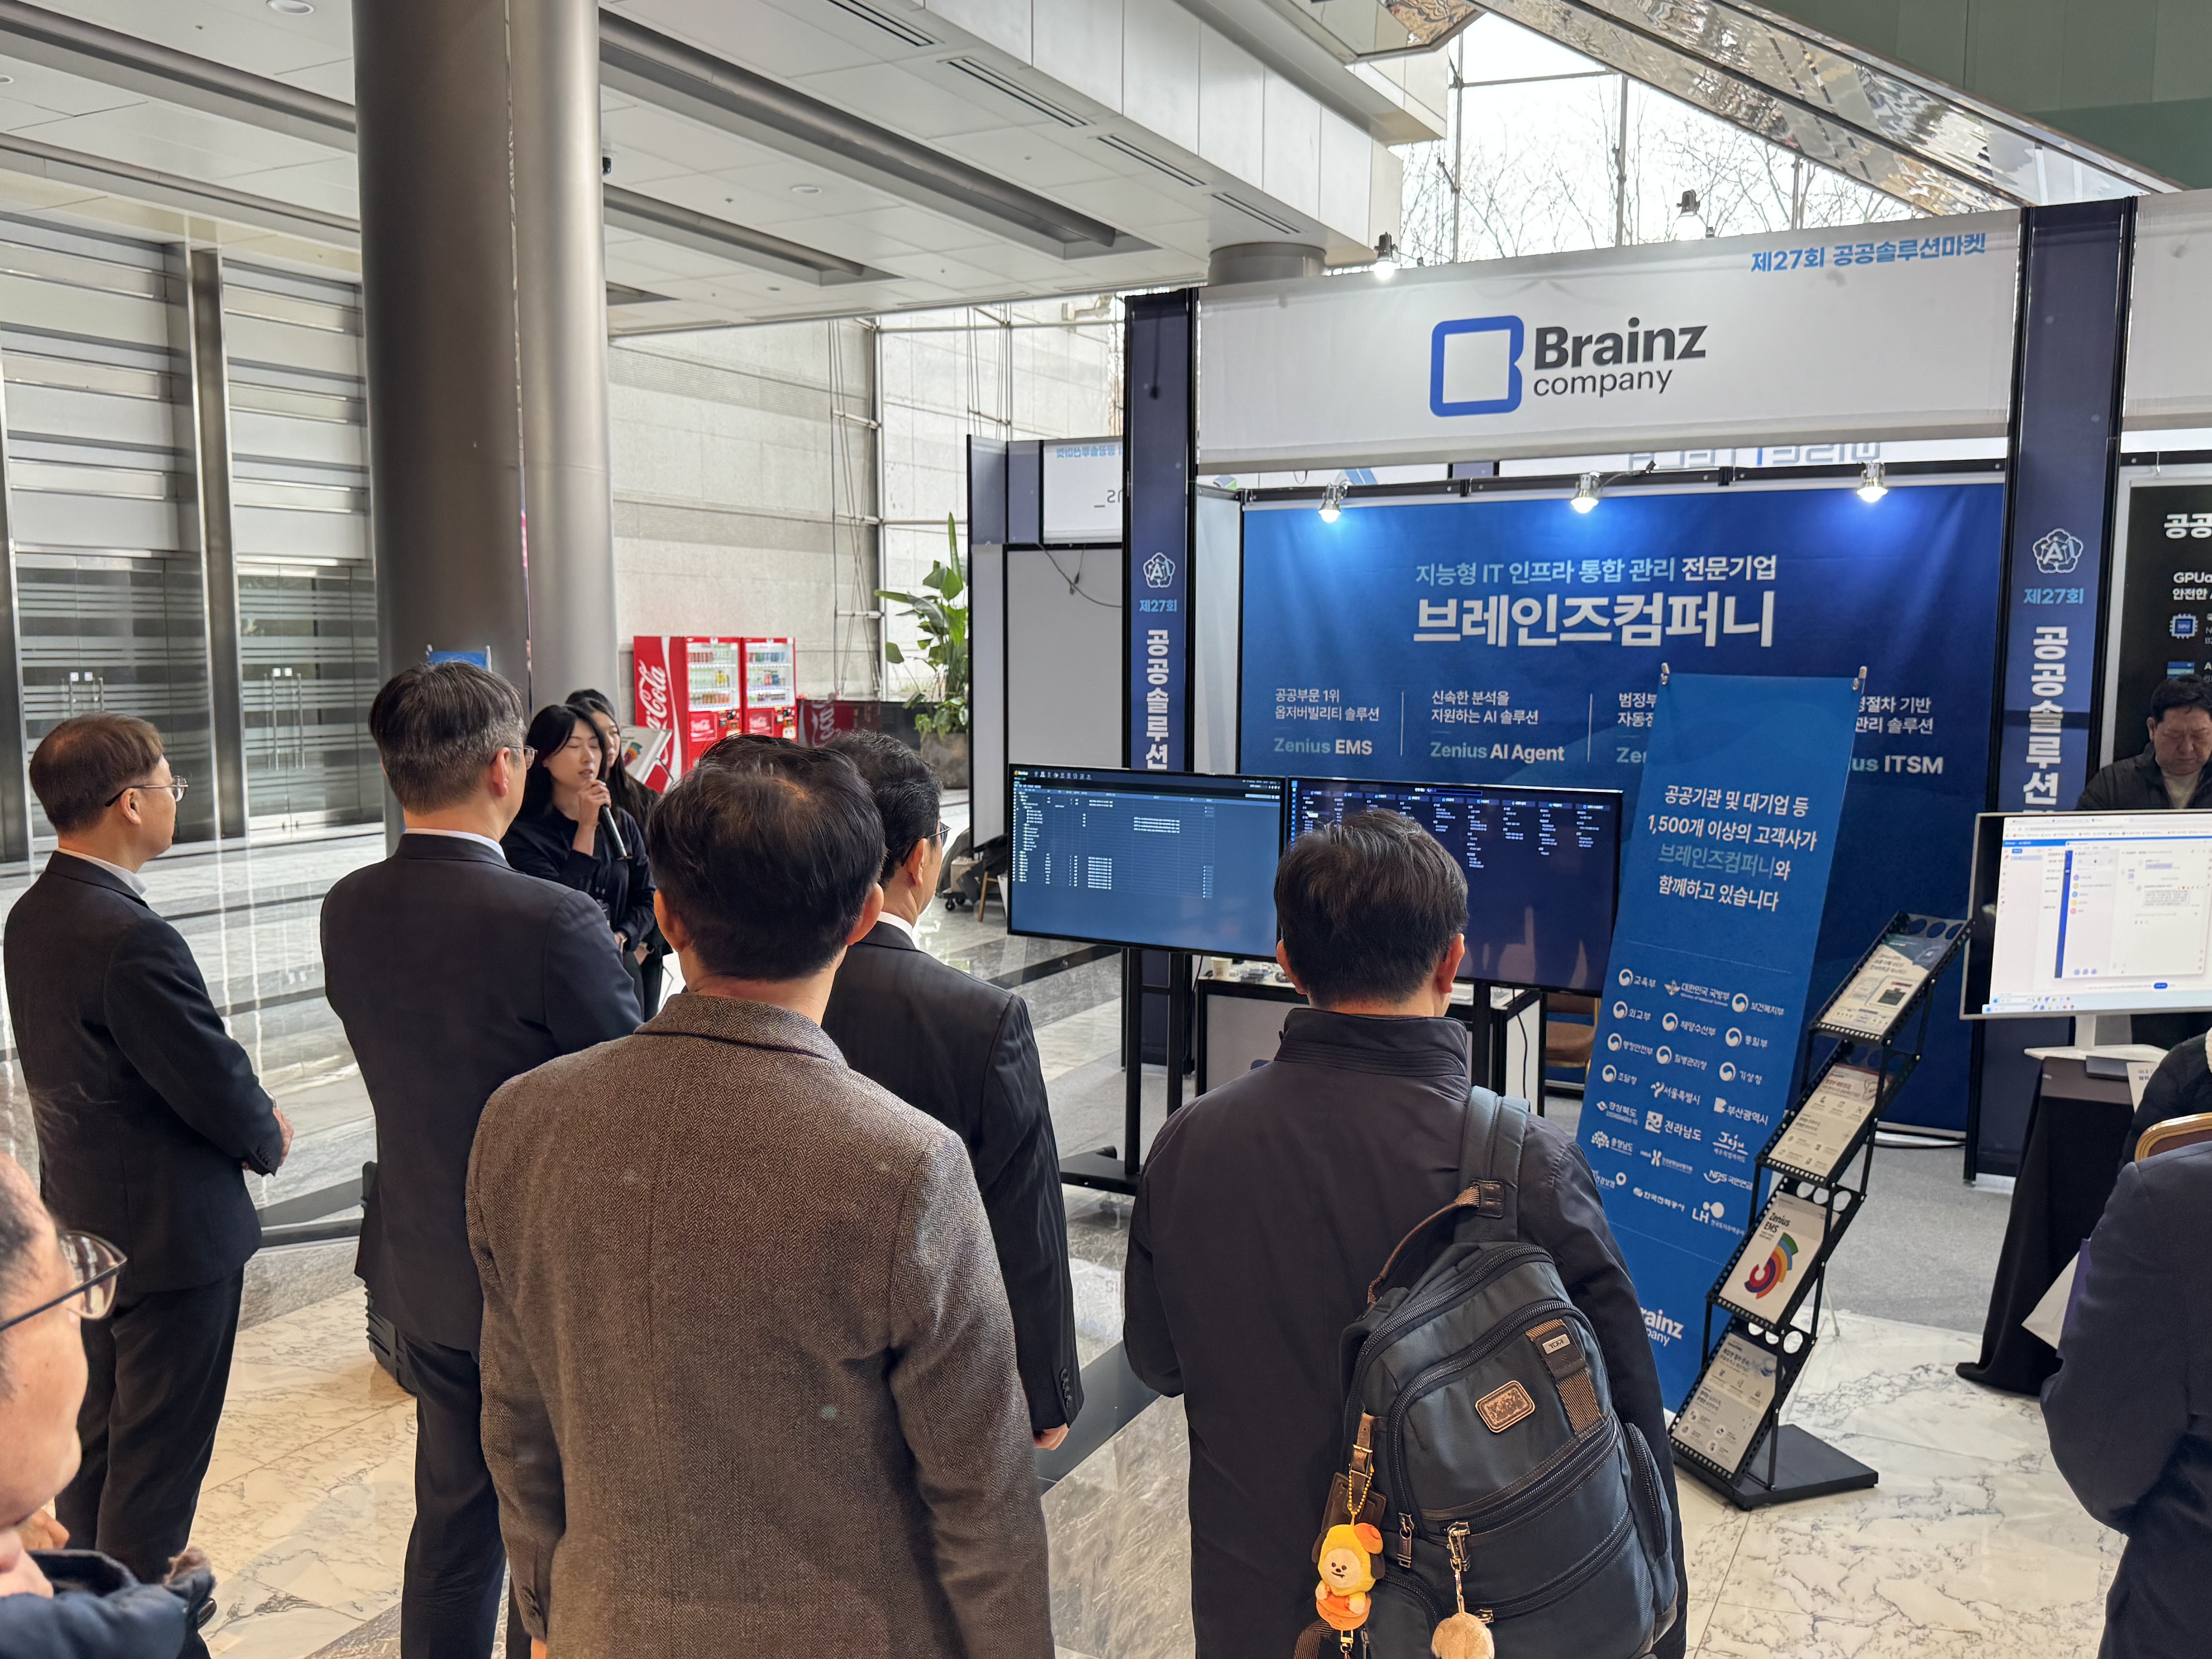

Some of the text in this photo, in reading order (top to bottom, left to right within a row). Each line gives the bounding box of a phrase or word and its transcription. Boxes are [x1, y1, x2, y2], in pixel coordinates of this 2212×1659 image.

[1751, 233, 1986, 272] 제27회 공공솔루션마켓
[1534, 317, 1708, 371] Brainz
[1534, 369, 1673, 398] company
[2164, 513, 2212, 539] 공공
[1416, 555, 1777, 586] 지능형 IT 인프라 통합 관리 전문기업
[2023, 587, 2084, 605] 제27회
[2172, 587, 2208, 600] 안전한
[1139, 599, 1177, 613] 제27회
[1413, 591, 1774, 647] 브레인즈컴퍼니
[1275, 689, 1340, 703] 공공부문 1위
[1432, 690, 1510, 706] 신속한 분석을
[1900, 697, 1931, 713] 기반
[1275, 706, 1379, 721] 옵저버빌리티 솔루션
[1431, 709, 1539, 725] 지원하는 AI 솔루션
[2023, 626, 2068, 809] 공공솔루션
[1887, 717, 1933, 735] 솔루션
[1274, 738, 1372, 755] Zenius EMS
[1431, 742, 1565, 764] Zenius AI Agent
[1884, 755, 1944, 774] ITSM
[1665, 785, 1809, 817] 공공기관 및 대기업 등
[1648, 814, 1817, 852] 1,500개 이상의 고객사가
[1658, 843, 1791, 881] 브레인즈컴퍼니와
[1659, 875, 1779, 912] 함께하고 있습니다
[1634, 975, 1656, 988] 교육부
[1681, 982, 1708, 996] 대한민국
[1628, 1008, 1651, 1021] 외교부
[1681, 1020, 1716, 1037] 해양수산부
[1739, 1071, 1762, 1085] 기상청
[1664, 1087, 1700, 1106] 서울특별시
[1727, 1105, 1769, 1126] 부산광역시
[1664, 1120, 1702, 1141] 전라남도
[1692, 1207, 1709, 1224] LH
[1769, 1212, 1790, 1226] Zenius
[1764, 1221, 1779, 1233] EMS
